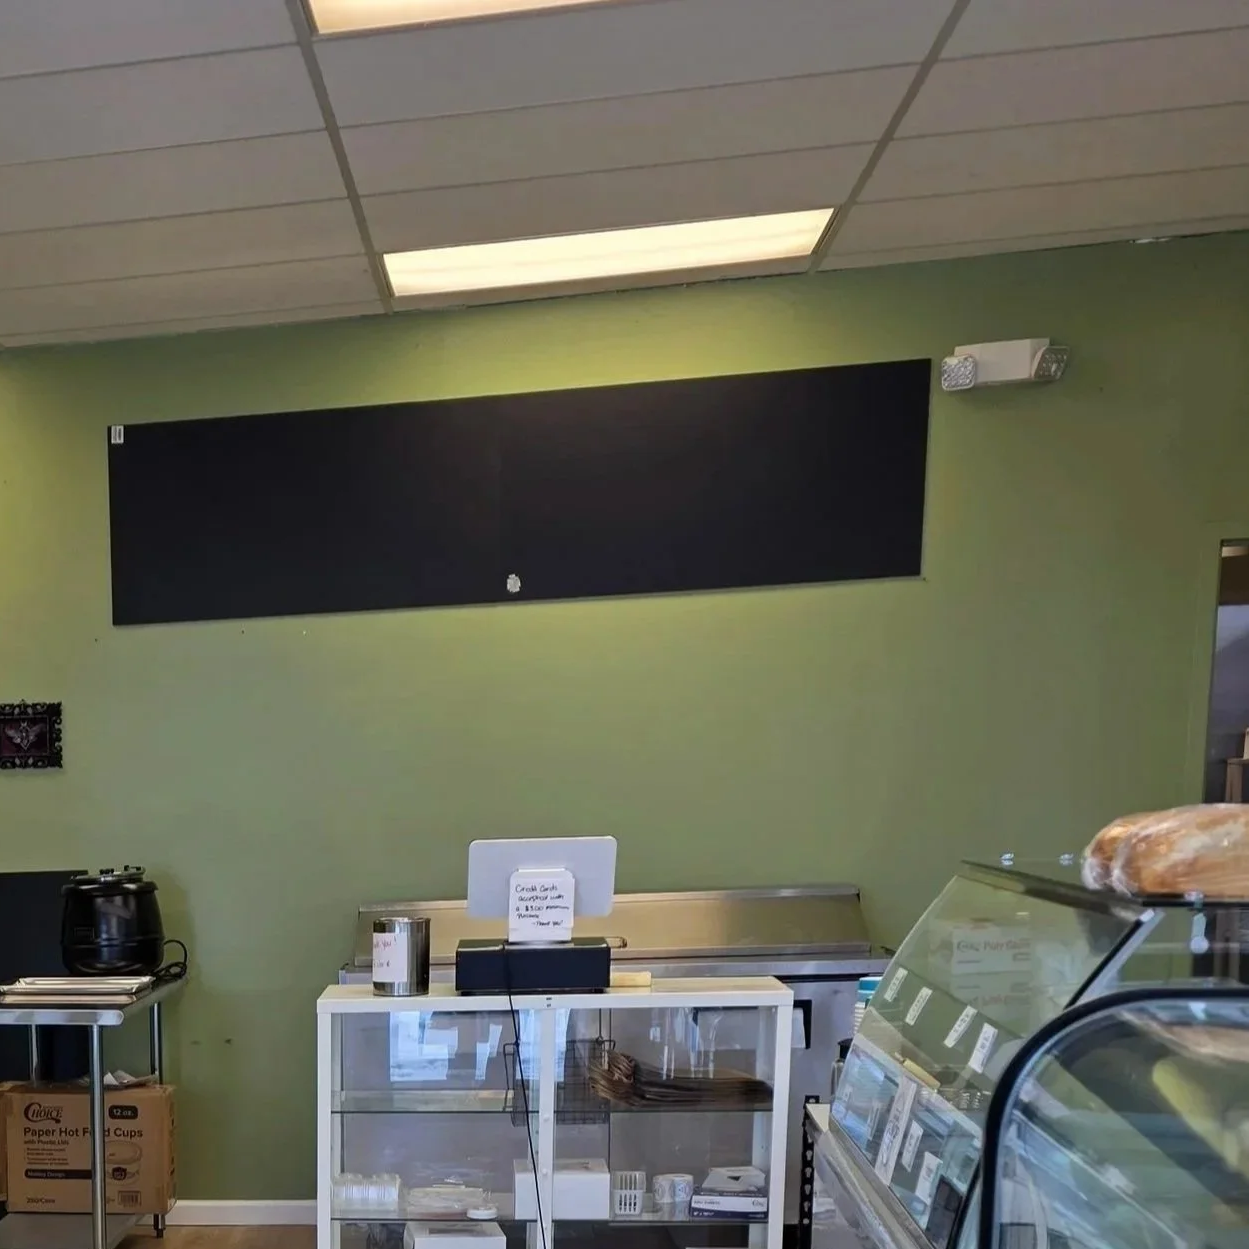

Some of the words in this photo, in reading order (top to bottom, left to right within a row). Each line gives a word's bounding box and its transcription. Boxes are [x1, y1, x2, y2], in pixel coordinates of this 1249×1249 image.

[24, 1127, 55, 1138] Paper
[59, 1127, 79, 1137] Hot
[82, 1127, 110, 1137] Fd
[114, 1127, 143, 1139] Cups
